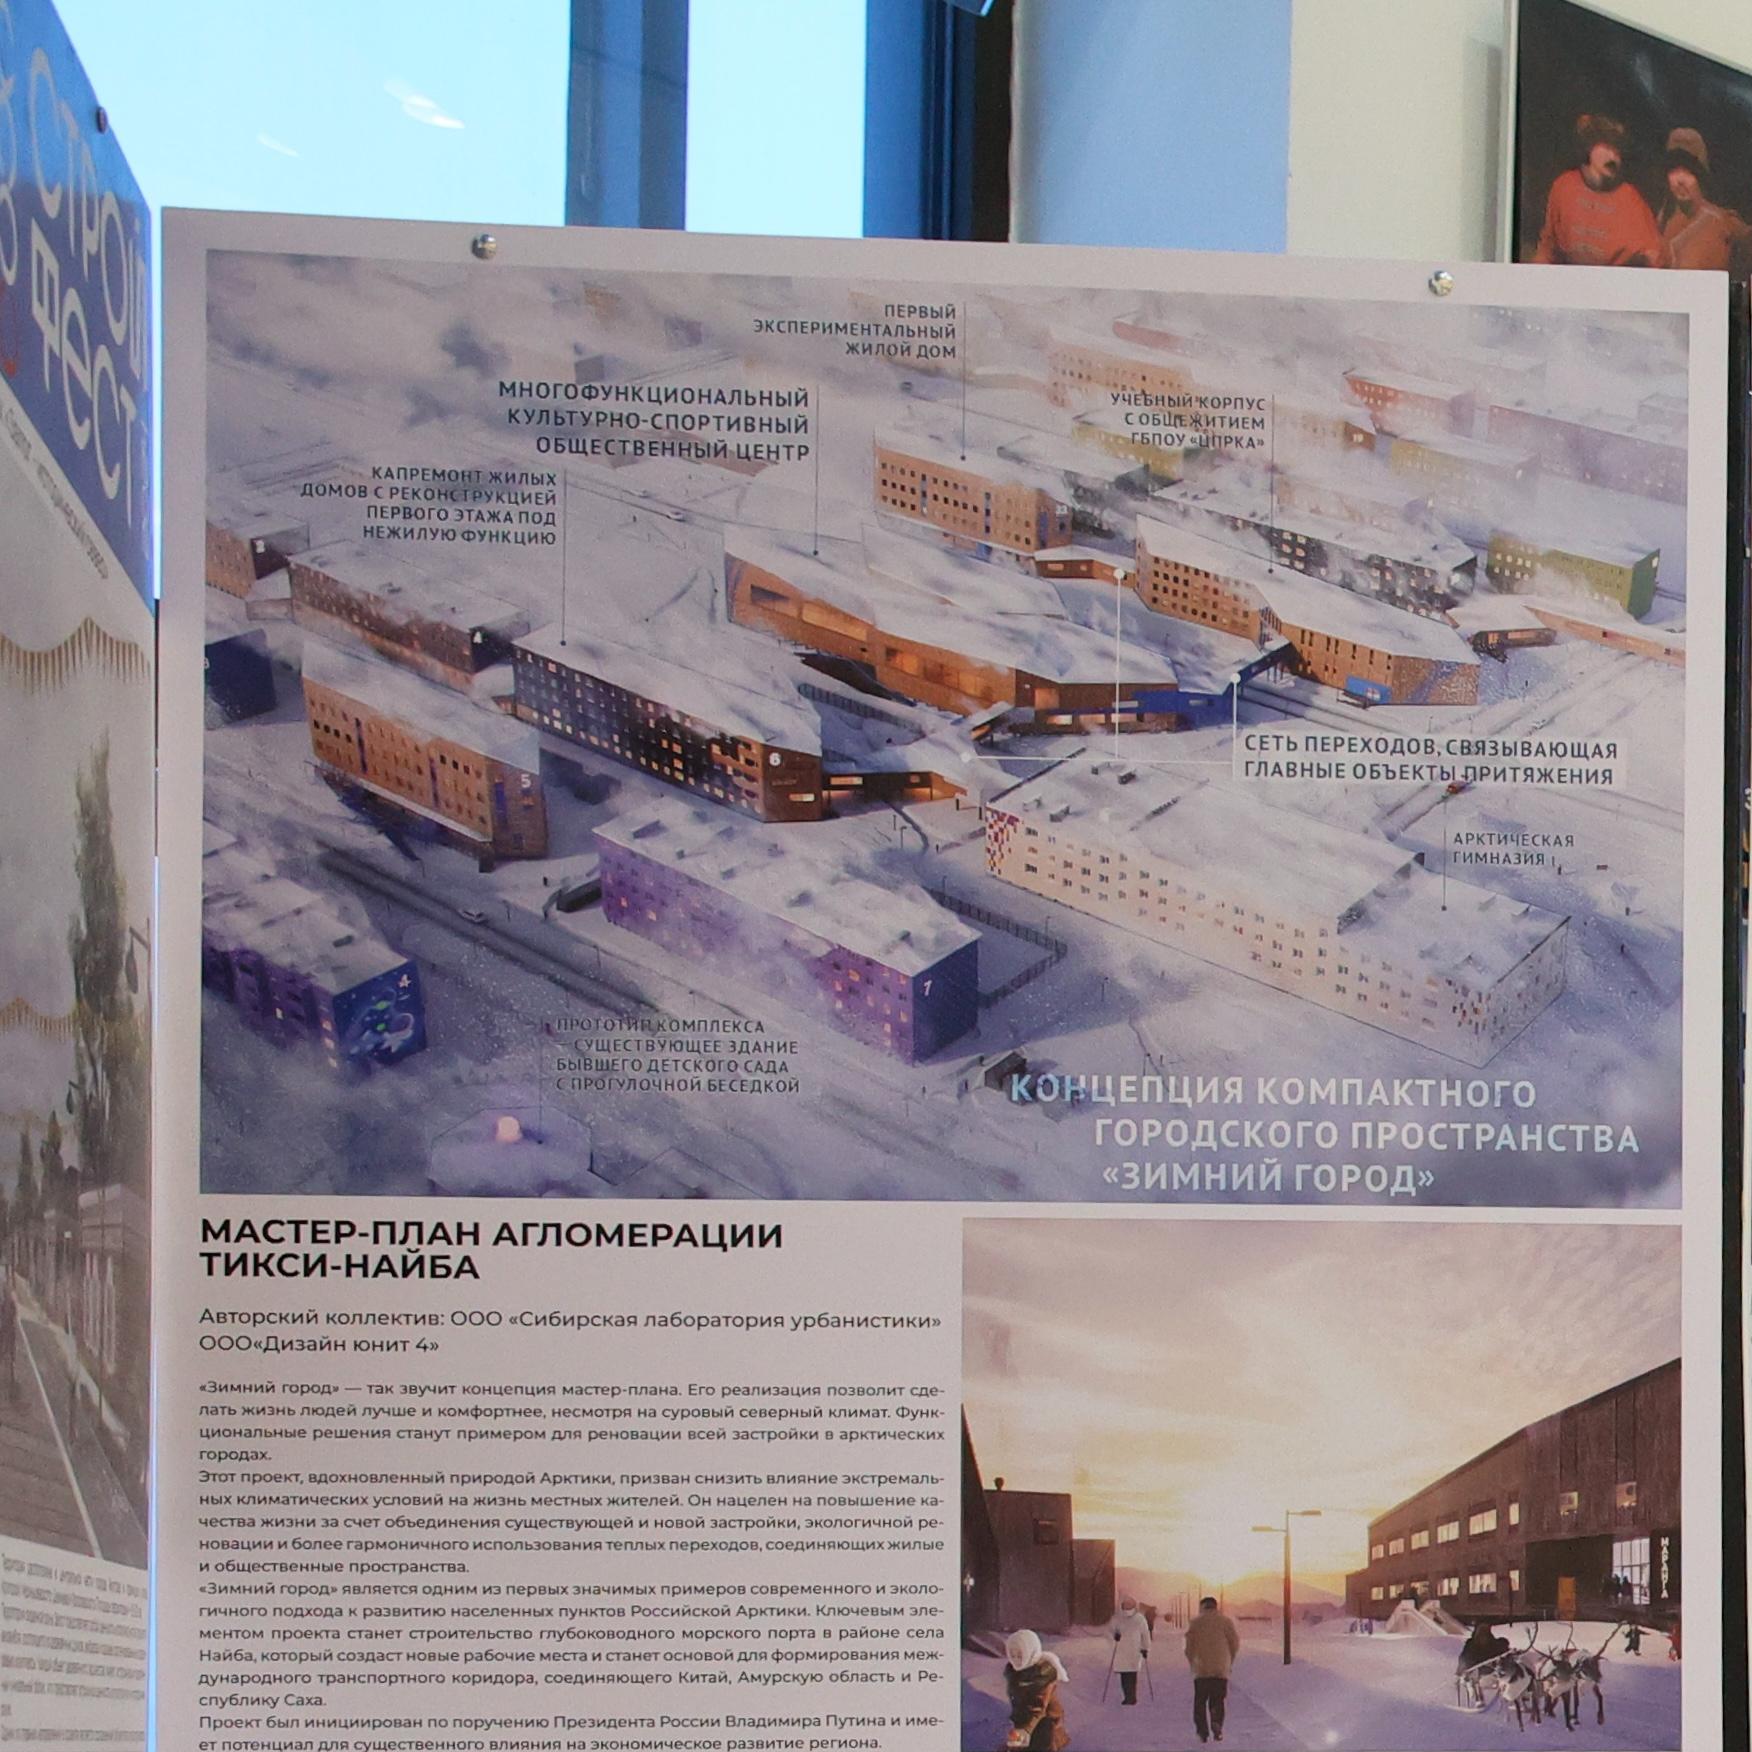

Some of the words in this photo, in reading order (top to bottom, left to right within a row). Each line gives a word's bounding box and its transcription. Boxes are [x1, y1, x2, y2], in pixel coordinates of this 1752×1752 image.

[884, 303, 955, 319] ПЕРВЫЙ
[753, 317, 955, 339] ЭКСПЕРИМЕНТАЛЬНЫЙ
[845, 340, 911, 358] ЖИЛОЙ
[915, 344, 956, 361] ДОМ
[498, 380, 809, 410] МНОГОФУНКЦИОНАЛЬНЫЙ
[1111, 392, 1193, 408] УЧЕБНЫЙ
[1200, 396, 1265, 410] КОРПУС
[507, 408, 809, 436] КУЛЬТУРНО-СПОРТИВНЫЙ
[1139, 412, 1265, 430] ОБЩЕЖИТИЕМ
[1131, 432, 1185, 447] ГБПОУ
[536, 436, 729, 461] ОБЩЕСТВЕННЫЙ
[735, 443, 809, 466] ЦЕНТР
[371, 465, 482, 483] КАПРЕМОНТ
[488, 471, 556, 486] ЖИЛЫХ
[301, 482, 368, 504] ДОМОВ
[390, 484, 556, 509] РЕКОНСТРУКЦИЕЙ
[367, 503, 448, 523] ПЕРВОГО
[453, 507, 513, 524] ЭТАЖА
[518, 510, 556, 527] ПОД
[362, 524, 456, 541] НЕЖИЛУЮ
[460, 528, 556, 547] ФУНКЦИЮ
[1245, 733, 1297, 752] СЕТЬ
[1305, 735, 1441, 757] ПЕРЕХОДОВ,
[1445, 738, 1617, 761] СВЯЗЫВАЮЩАЯ
[1244, 761, 1346, 780] ГЛАВНЫЕ
[1352, 764, 1457, 782] ОБЪЕКТЫ
[1464, 766, 1614, 785] ПРИТЯЖЕНИЯ
[1453, 830, 1574, 847] АРКТИЧЕСКАЯ
[1453, 849, 1544, 865] ГИМНАЗИЯ
[657, 1020, 765, 1034] КОМПЛЕКСА
[574, 1039, 721, 1054] СУЩЕСТВУЮЩЕЕ
[728, 1039, 798, 1056] ЗДАНИЕ
[556, 1057, 642, 1073] БЫВШЕГО
[646, 1058, 738, 1074] ДЕТСКОГО
[743, 1059, 788, 1075] САДА
[571, 1076, 702, 1092] ПРОГУЛОЧНОЙ
[707, 1075, 799, 1094] БЕСЕДКОЙ
[1010, 1070, 1244, 1110] КОНЦЕПЦИЯ
[1258, 1076, 1535, 1108] КОМПАКТНОГО
[1095, 1117, 1338, 1153] ГОРОДСКОГО
[1351, 1116, 1639, 1153] ПРОСТРАНСТВА
[1102, 1155, 1282, 1191] «ЗИМНИЙ
[1291, 1158, 1434, 1197] ГОРОД»
[201, 1218, 479, 1252] МАСТЕР-ПЛАН
[492, 1222, 781, 1252] АГЛОМЕРАЦИИ
[199, 1246, 480, 1280] ТИКСИ-НАЙБА
[198, 1307, 318, 1328] Авторский
[325, 1312, 444, 1325] коллектив:
[450, 1310, 502, 1326] ООО
[508, 1310, 637, 1330] «Сибирская
[643, 1311, 784, 1331] лаборатория
[790, 1311, 941, 1332] урбанистики»
[353, 1339, 410, 1352] юнит
[415, 1337, 439, 1352] 4»
[199, 1380, 275, 1393] «Зимний
[281, 1383, 339, 1396] город»
[366, 1384, 393, 1394] так
[399, 1384, 457, 1397] звучит
[462, 1385, 556, 1397] концепция
[562, 1385, 682, 1398] мастер-плана.
[687, 1383, 715, 1396] Его
[721, 1385, 821, 1398] реализация
[827, 1386, 905, 1396] позволит
[909, 1386, 944, 1398] сде-
[199, 1405, 237, 1415] лать
[241, 1405, 296, 1416] жизнь
[299, 1403, 356, 1418] людей
[361, 1406, 416, 1419] лучше
[437, 1404, 546, 1420] комфортнее,
[551, 1407, 632, 1420] несмотря
[637, 1408, 656, 1418] на
[661, 1405, 734, 1421] суровый
[739, 1405, 822, 1421] северный
[828, 1408, 891, 1418] климат.
[895, 1405, 944, 1421] Функ-
[199, 1427, 307, 1440] циональные
[312, 1428, 391, 1441] решения
[396, 1428, 451, 1442] станут
[456, 1429, 546, 1442] примером
[550, 1429, 581, 1441] для
[587, 1429, 681, 1442] реновации
[687, 1427, 726, 1440] всей
[732, 1427, 818, 1443] застройки
[839, 1430, 944, 1443] арктических
[198, 1470, 236, 1483] Этот
[240, 1472, 303, 1485] проект,
[308, 1471, 445, 1485] вдохновленный
[449, 1471, 535, 1486] природой
[539, 1471, 615, 1486] Арктики,
[619, 1474, 690, 1487] призван
[694, 1474, 762, 1484] снизить
[766, 1474, 838, 1484] влияние
[841, 1474, 944, 1487] экстремаль-
[199, 1715, 262, 1731] Проект
[265, 1715, 299, 1728] был
[304, 1718, 422, 1730] инициирован
[427, 1718, 448, 1728] по
[452, 1718, 549, 1731] поручению
[553, 1715, 655, 1730] Президента
[659, 1715, 720, 1728] России
[725, 1714, 821, 1729] Владимира
[825, 1714, 886, 1729] Путина
[905, 1716, 943, 1726] име-
